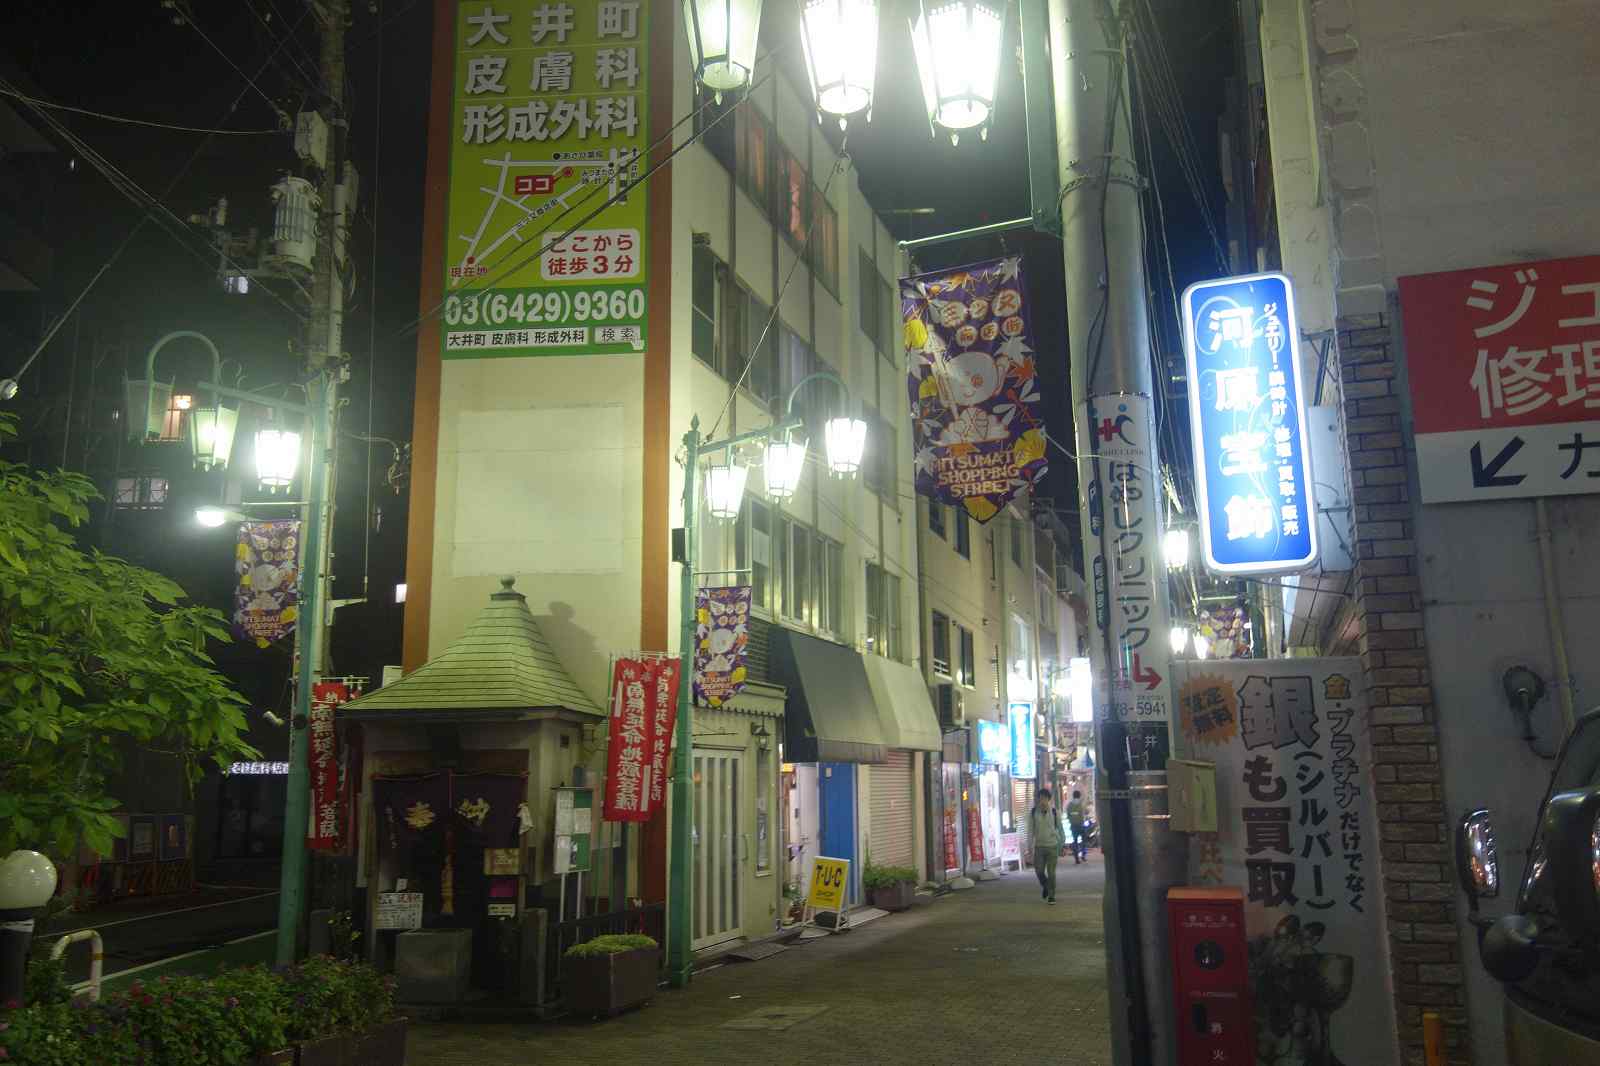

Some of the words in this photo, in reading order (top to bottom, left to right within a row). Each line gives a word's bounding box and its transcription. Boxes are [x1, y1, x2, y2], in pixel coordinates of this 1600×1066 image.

[466, 1, 640, 46] 大井町
[464, 48, 640, 94] 皮膚科
[463, 96, 639, 144] 形成外科
[517, 178, 550, 192] ココ
[550, 234, 633, 253] ここから
[548, 255, 633, 275] 徒歩3分
[444, 289, 644, 325] 03(6429)9360
[449, 334, 485, 346] 大井町
[492, 332, 529, 345] 皮膚科
[534, 330, 585, 344] 形成外科
[601, 328, 634, 341] 検索
